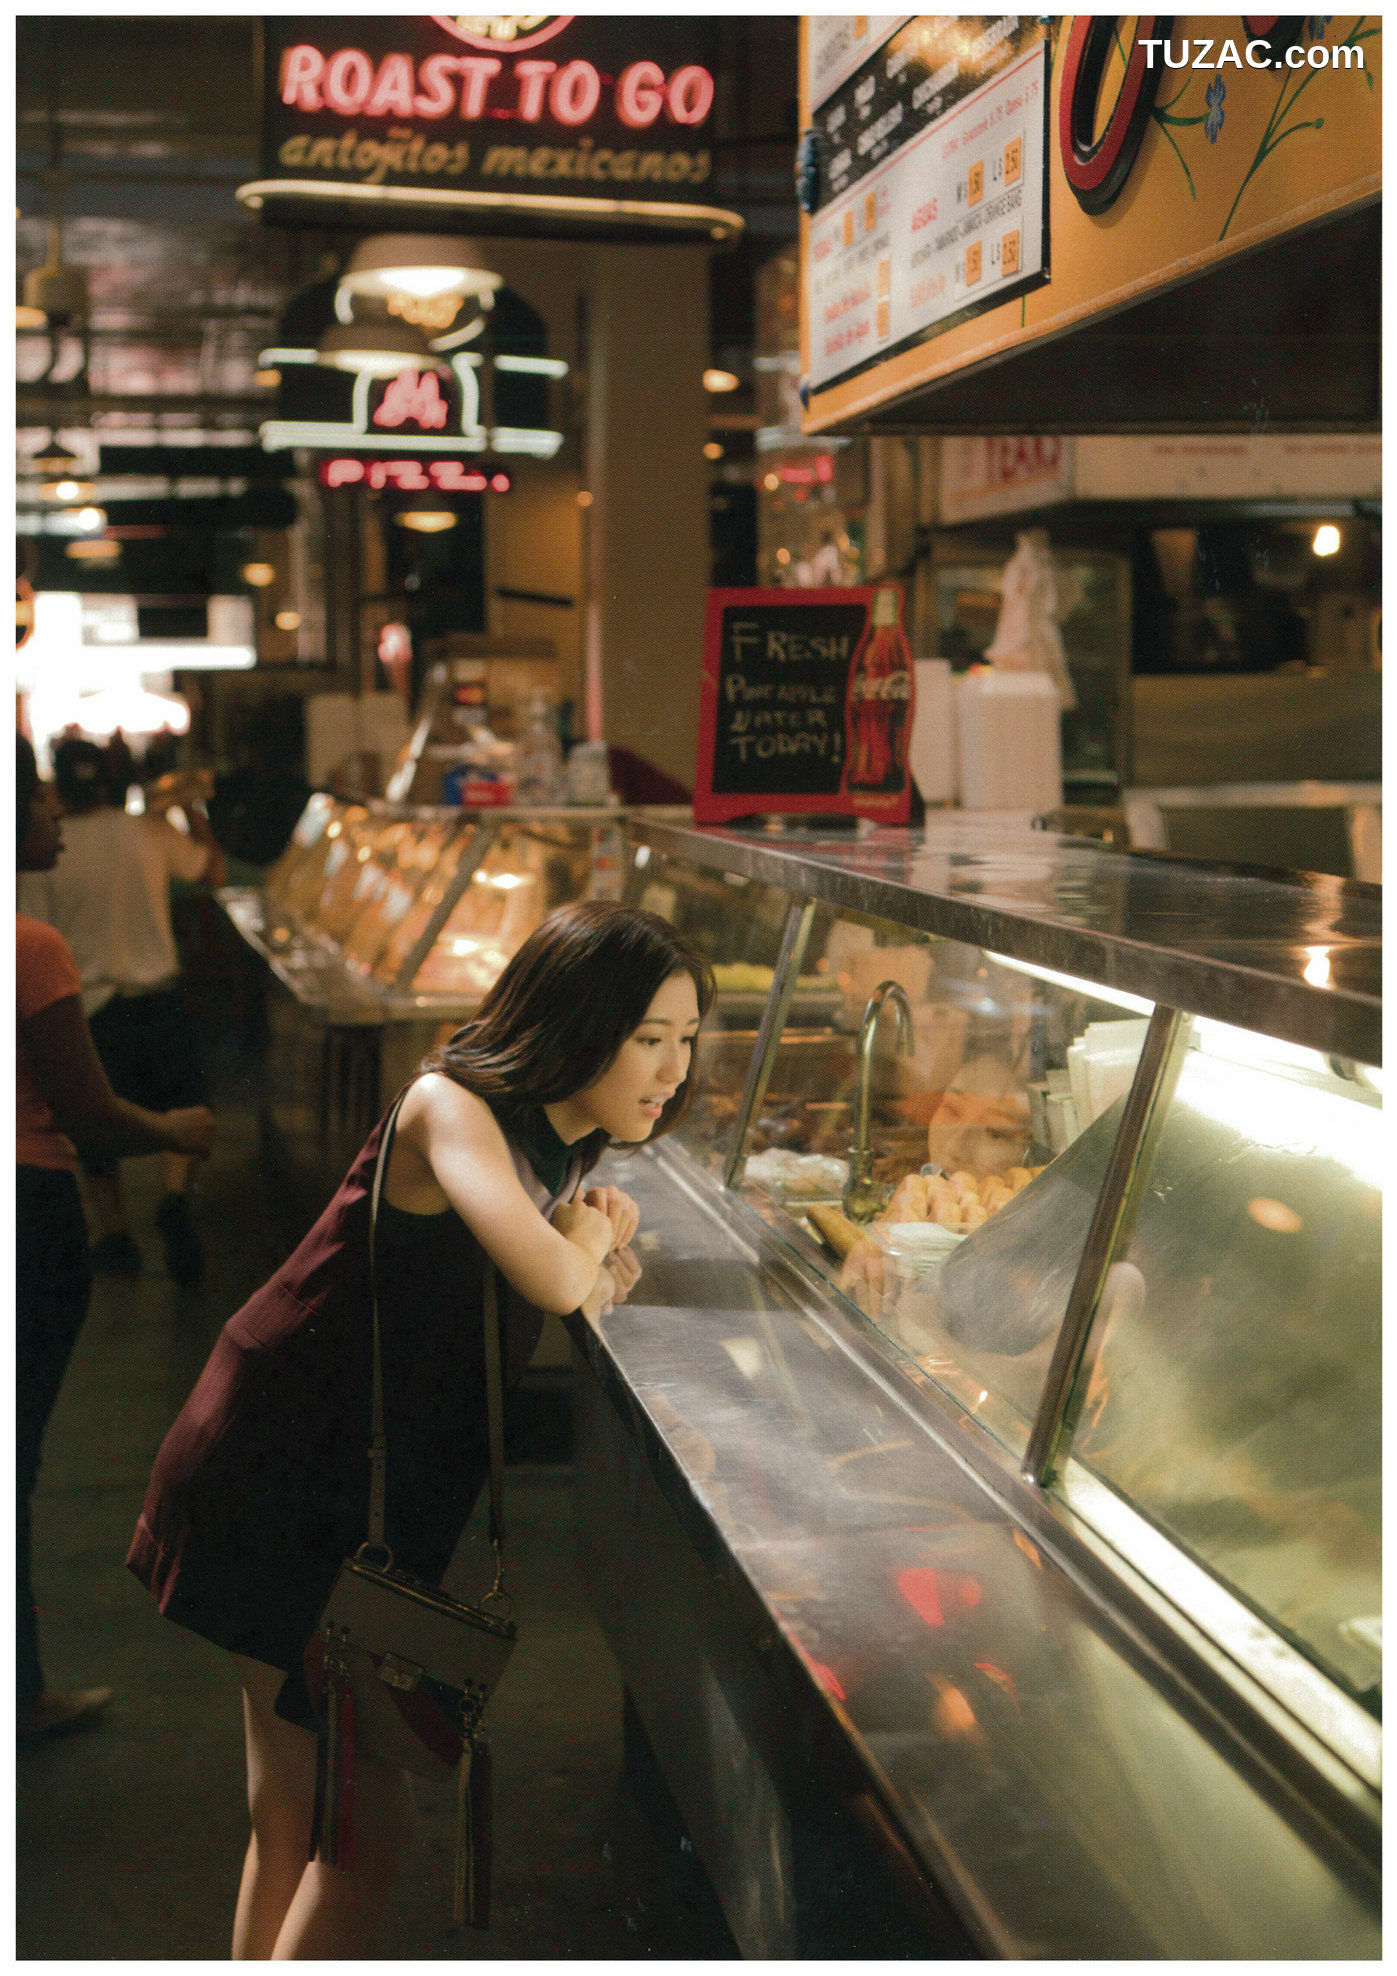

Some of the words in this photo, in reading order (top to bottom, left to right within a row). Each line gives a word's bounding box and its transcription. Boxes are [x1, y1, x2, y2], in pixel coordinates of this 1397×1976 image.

[281, 44, 502, 120] ROAST
[514, 59, 600, 125] TO
[617, 60, 715, 128] GO
[481, 136, 711, 183] mexicanos
[730, 621, 850, 663] FRESH
[729, 730, 842, 765] TODAY!
